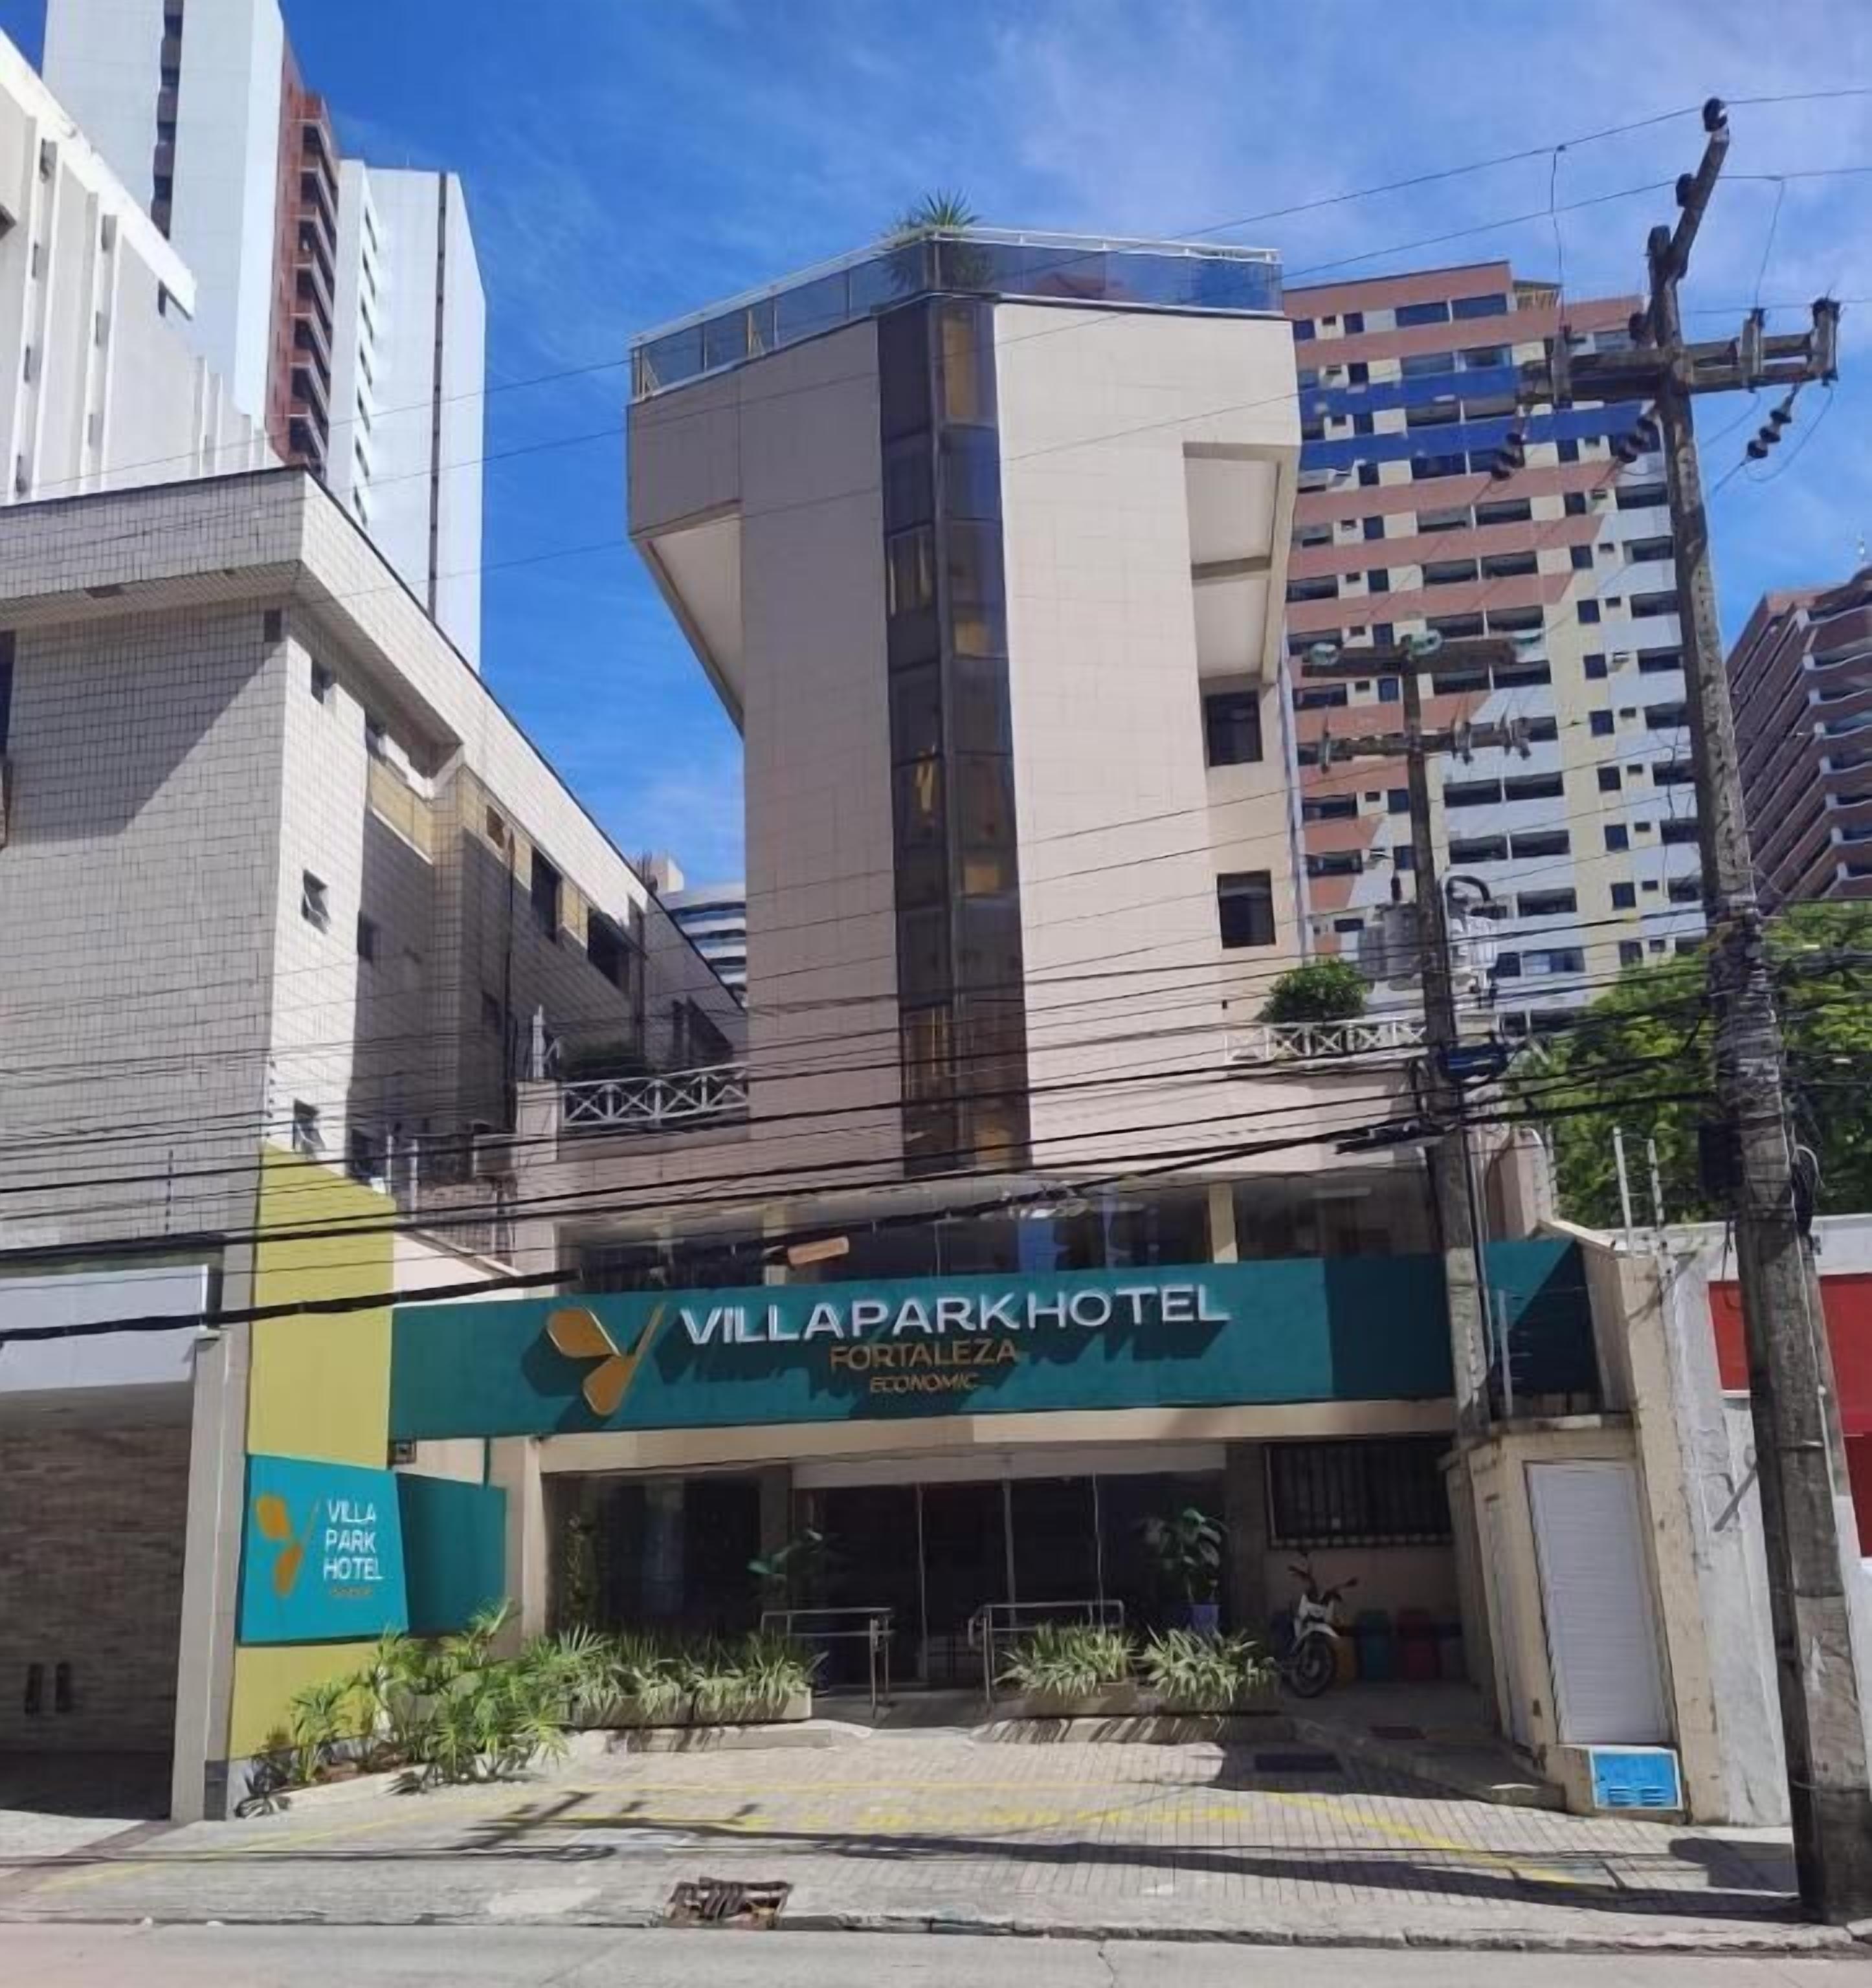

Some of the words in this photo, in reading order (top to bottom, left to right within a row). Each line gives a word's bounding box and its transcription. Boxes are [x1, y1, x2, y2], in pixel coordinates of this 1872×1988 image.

[680, 1302, 845, 1345] VILLA
[851, 1292, 1021, 1338] PARK
[1027, 1283, 1232, 1330] HOTEL
[830, 1338, 1018, 1372] FORTALEZA
[869, 1373, 979, 1394] ECONOMIC
[327, 1498, 377, 1523] VILLA
[324, 1528, 376, 1554] PARK
[323, 1556, 384, 1581] HOTEL
